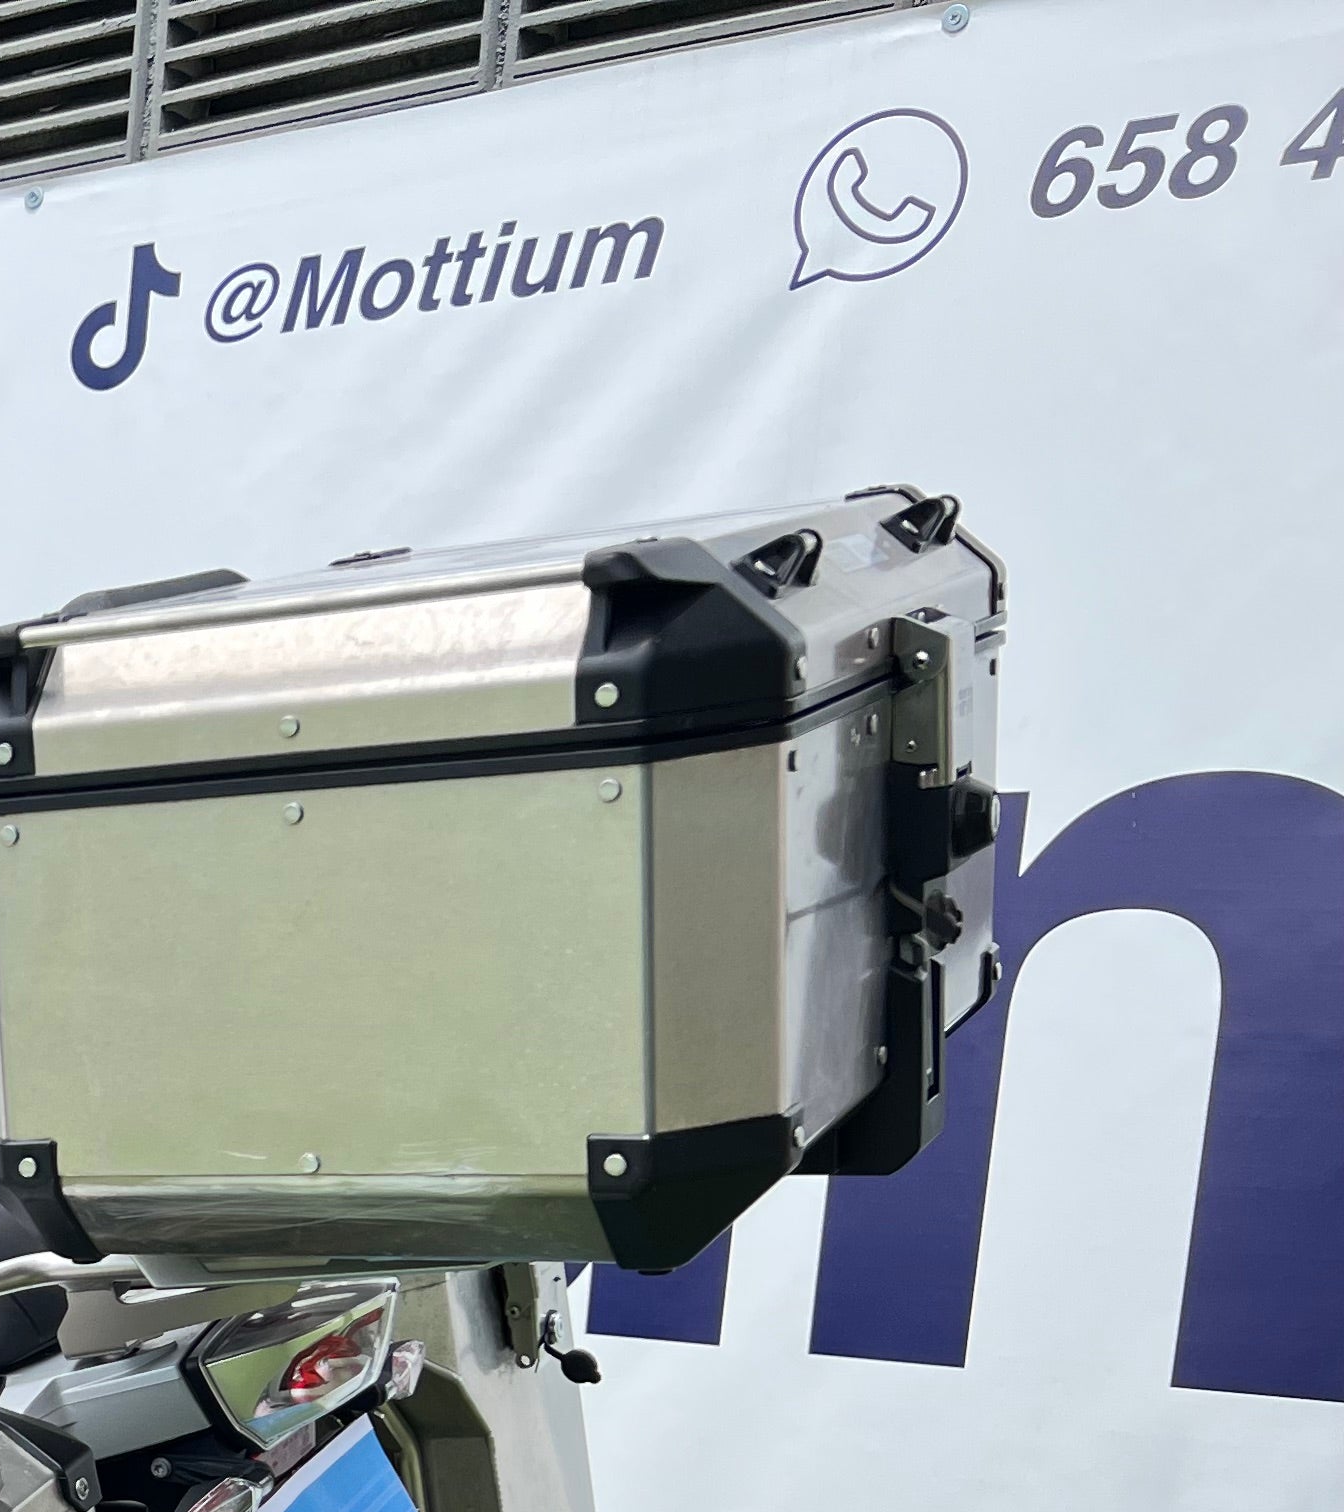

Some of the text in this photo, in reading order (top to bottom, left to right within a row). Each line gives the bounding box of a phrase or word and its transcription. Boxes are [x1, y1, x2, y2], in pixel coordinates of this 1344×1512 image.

[1030, 86, 1344, 219] 658 4
[204, 215, 665, 344] @Mottium
